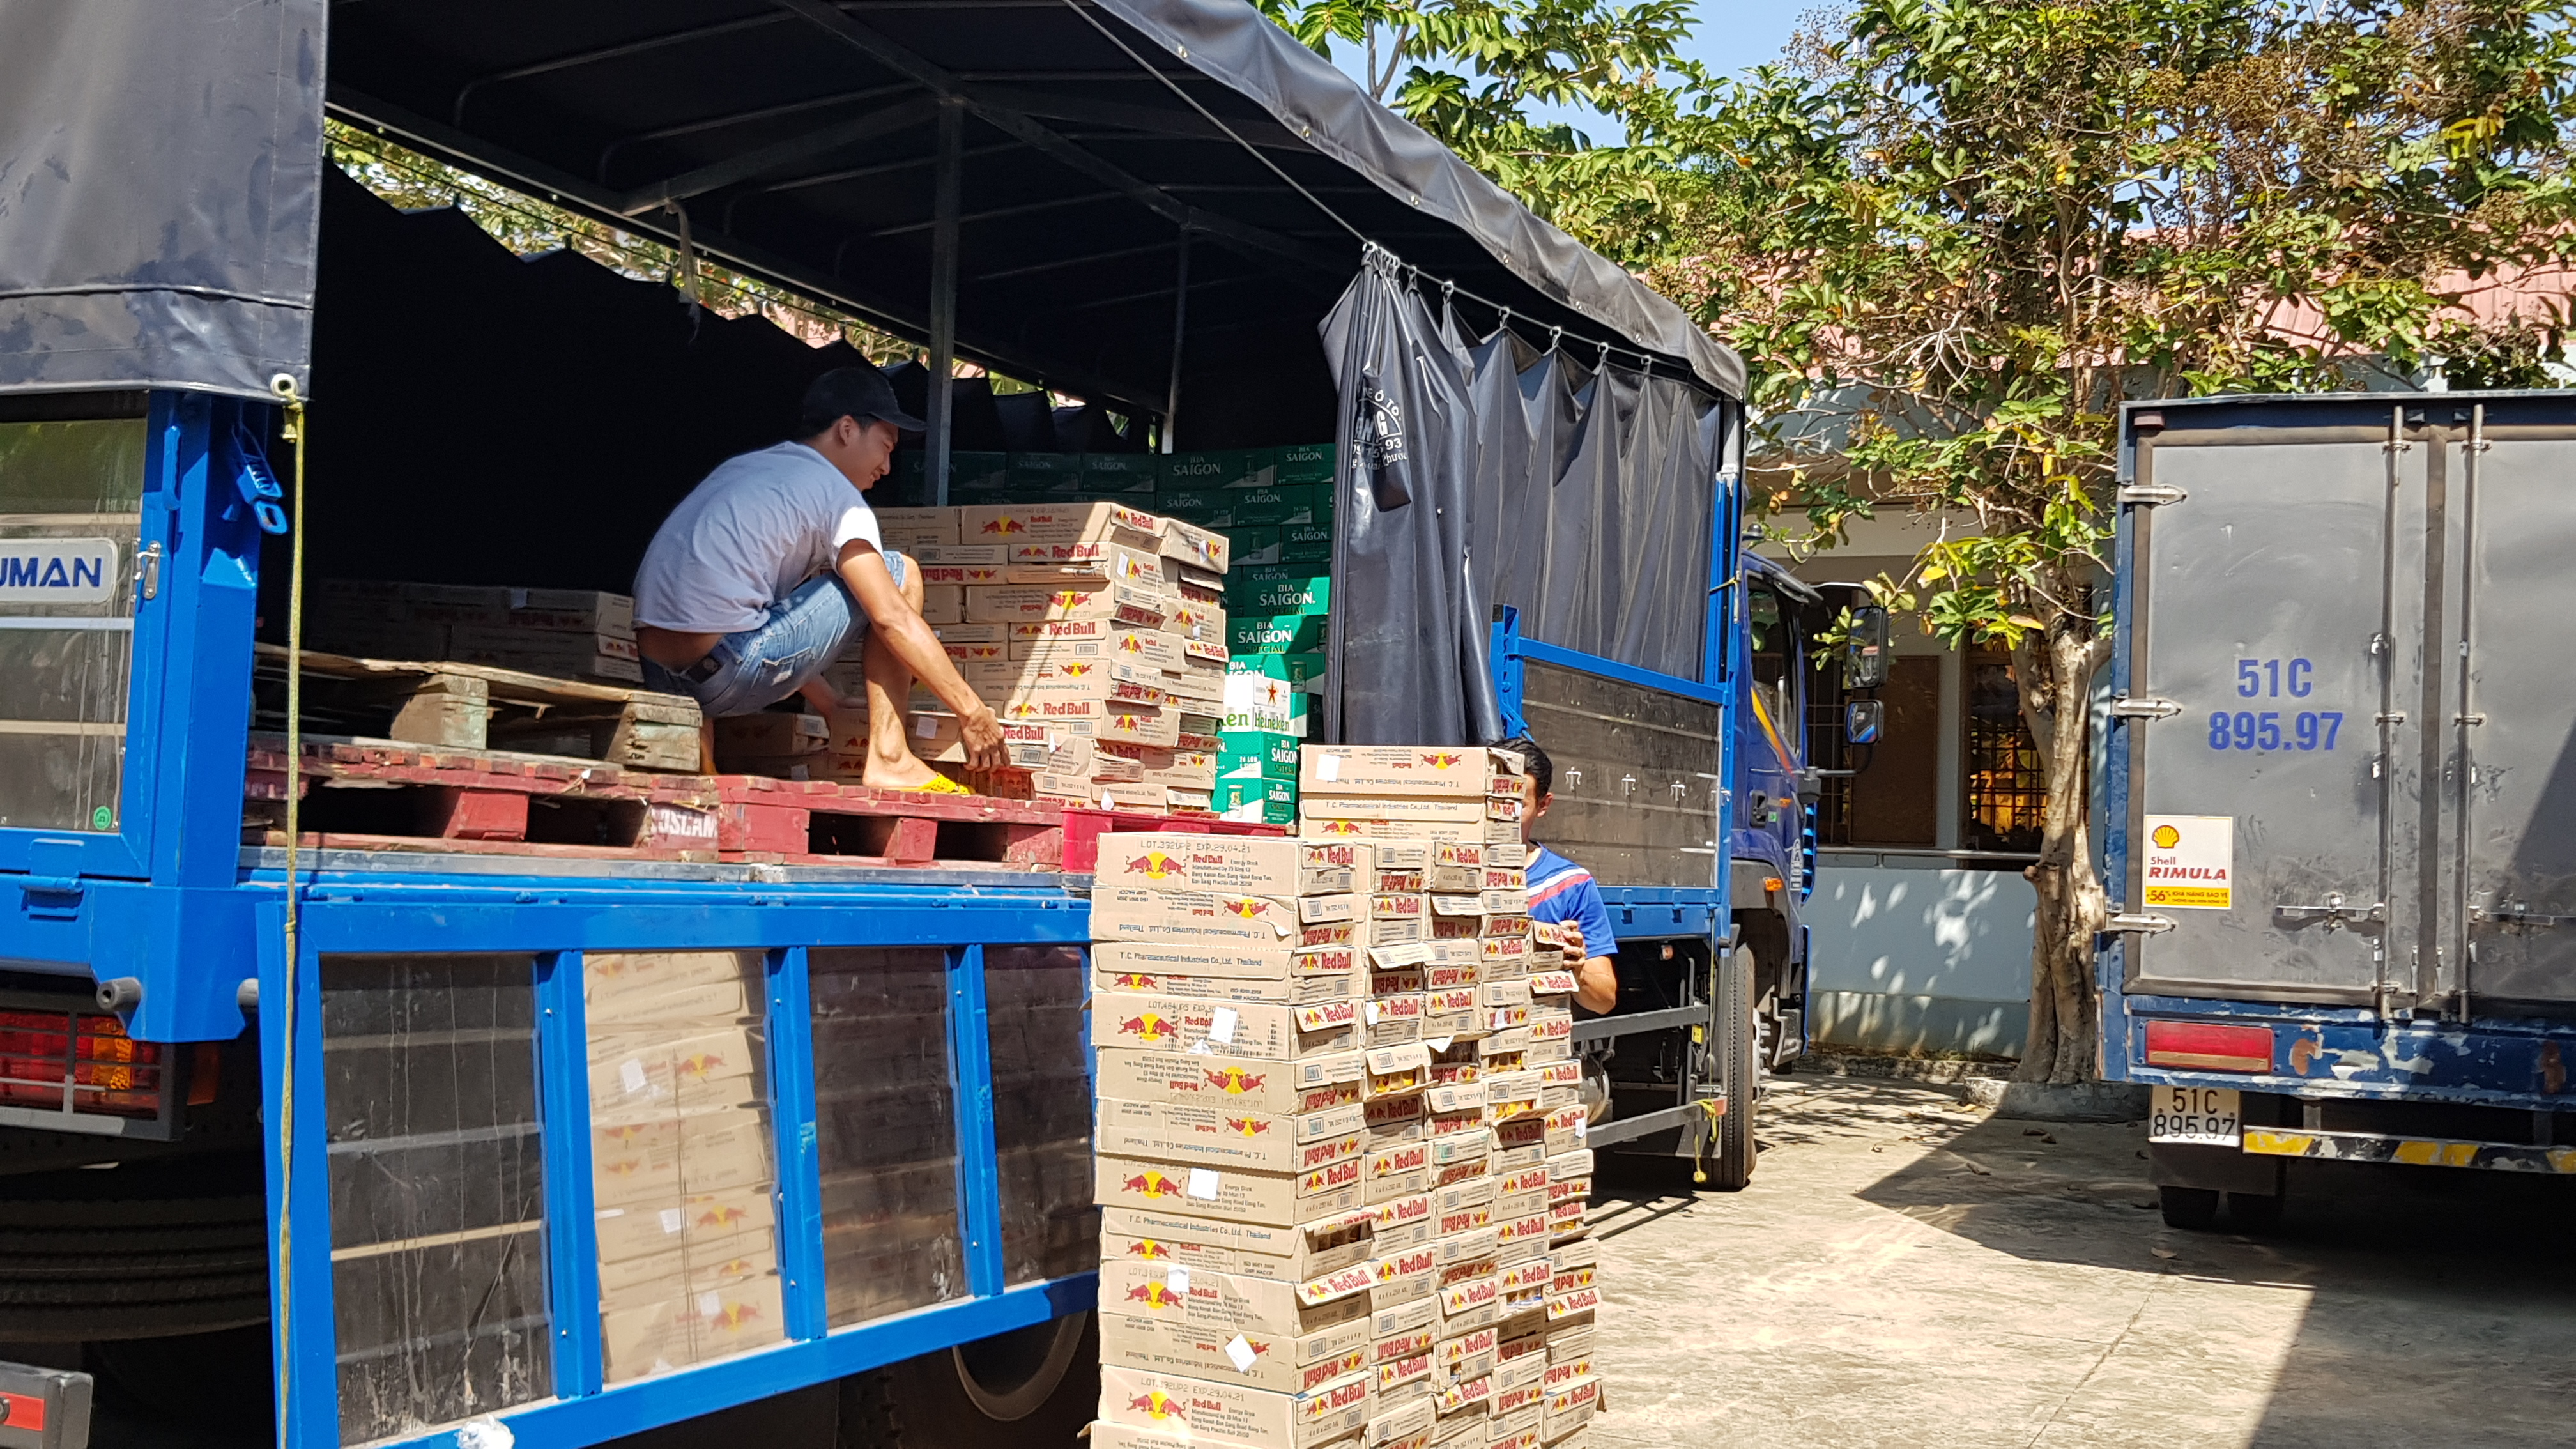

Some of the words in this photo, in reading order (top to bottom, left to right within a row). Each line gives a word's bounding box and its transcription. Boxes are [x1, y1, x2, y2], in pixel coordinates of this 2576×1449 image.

[1286, 451, 1322, 461] SAIGON
[1173, 463, 1222, 476] SAIGON
[1167, 498, 1202, 508] SAIGON
[1244, 494, 1280, 504] SAIGON
[1291, 531, 1328, 542] SAIGON
[1054, 544, 1076, 558] Red
[1076, 544, 1099, 557] Bull
[1049, 621, 1071, 635] Red
[1073, 622, 1096, 634] Bull
[1238, 629, 1292, 644] SAIGON
[1229, 661, 1246, 670] BIA
[2237, 658, 2312, 698] 51C
[1044, 703, 1066, 715] Red
[1068, 702, 1090, 714] Bull
[1223, 713, 1249, 726] en
[1255, 712, 1290, 732] Heineken
[1004, 725, 1023, 742] Red
[1023, 726, 1044, 740] Bull
[2208, 711, 2343, 751] 895.97
[1281, 740, 1290, 749] BIA
[1271, 748, 1298, 764] SAIGON
[1269, 790, 1290, 801] SAIGON
[2150, 857, 2176, 865] Shell
[2149, 867, 2227, 880] RIMULA
[1322, 953, 1337, 969] Red
[1336, 953, 1351, 969] Bull
[1391, 1000, 1405, 1015] Red
[1404, 999, 1418, 1015] Bull
[1447, 993, 1460, 1008] Red
[1459, 992, 1472, 1007] Bull
[1186, 1016, 1199, 1025] Red
[1199, 1018, 1213, 1026] Bull
[1323, 1004, 1340, 1022] Red
[1339, 1004, 1354, 1020] Bull
[2173, 1088, 2218, 1114] 51C
[2154, 1114, 2235, 1141] 895.97
[1305, 1147, 1319, 1166] Bull
[1319, 1144, 1337, 1163] Red
[1395, 1153, 1409, 1169] Red
[1408, 1149, 1423, 1167] Bull
[1328, 1167, 1342, 1184] Red
[1342, 1161, 1358, 1182] Bull
[1521, 1176, 1533, 1188] Red
[1533, 1172, 1546, 1187] Bull
[1398, 1203, 1412, 1218] Red
[1411, 1198, 1427, 1216] Bull
[1518, 1221, 1530, 1236] Red
[1529, 1218, 1545, 1234] Bull
[1400, 1256, 1416, 1274] Red
[1416, 1252, 1432, 1270] Bull
[1329, 1274, 1349, 1292] Red
[1349, 1270, 1371, 1289] Bull
[1523, 1269, 1536, 1283] Red
[1535, 1265, 1549, 1282] Bull
[1190, 1288, 1204, 1296] Red
[1203, 1289, 1218, 1298] Bull
[1468, 1285, 1483, 1303] Red
[1482, 1282, 1496, 1300] Bull
[1568, 1294, 1583, 1310] Red
[1582, 1291, 1598, 1307] Bull
[1379, 1341, 1394, 1360] Bull
[1394, 1338, 1411, 1356] Red
[1466, 1335, 1480, 1353] Red
[1479, 1331, 1493, 1349] Bull
[1319, 1361, 1339, 1383] Red
[1397, 1357, 1413, 1377] Red
[1413, 1354, 1428, 1372] Bull
[1305, 1367, 1320, 1388] Bull
[1331, 1388, 1348, 1407] Red
[1348, 1381, 1365, 1403] Bull
[1461, 1381, 1475, 1400] Red
[1475, 1377, 1489, 1398] Bull
[1193, 1399, 1206, 1408] Red
[1205, 1400, 1221, 1411] Bull
